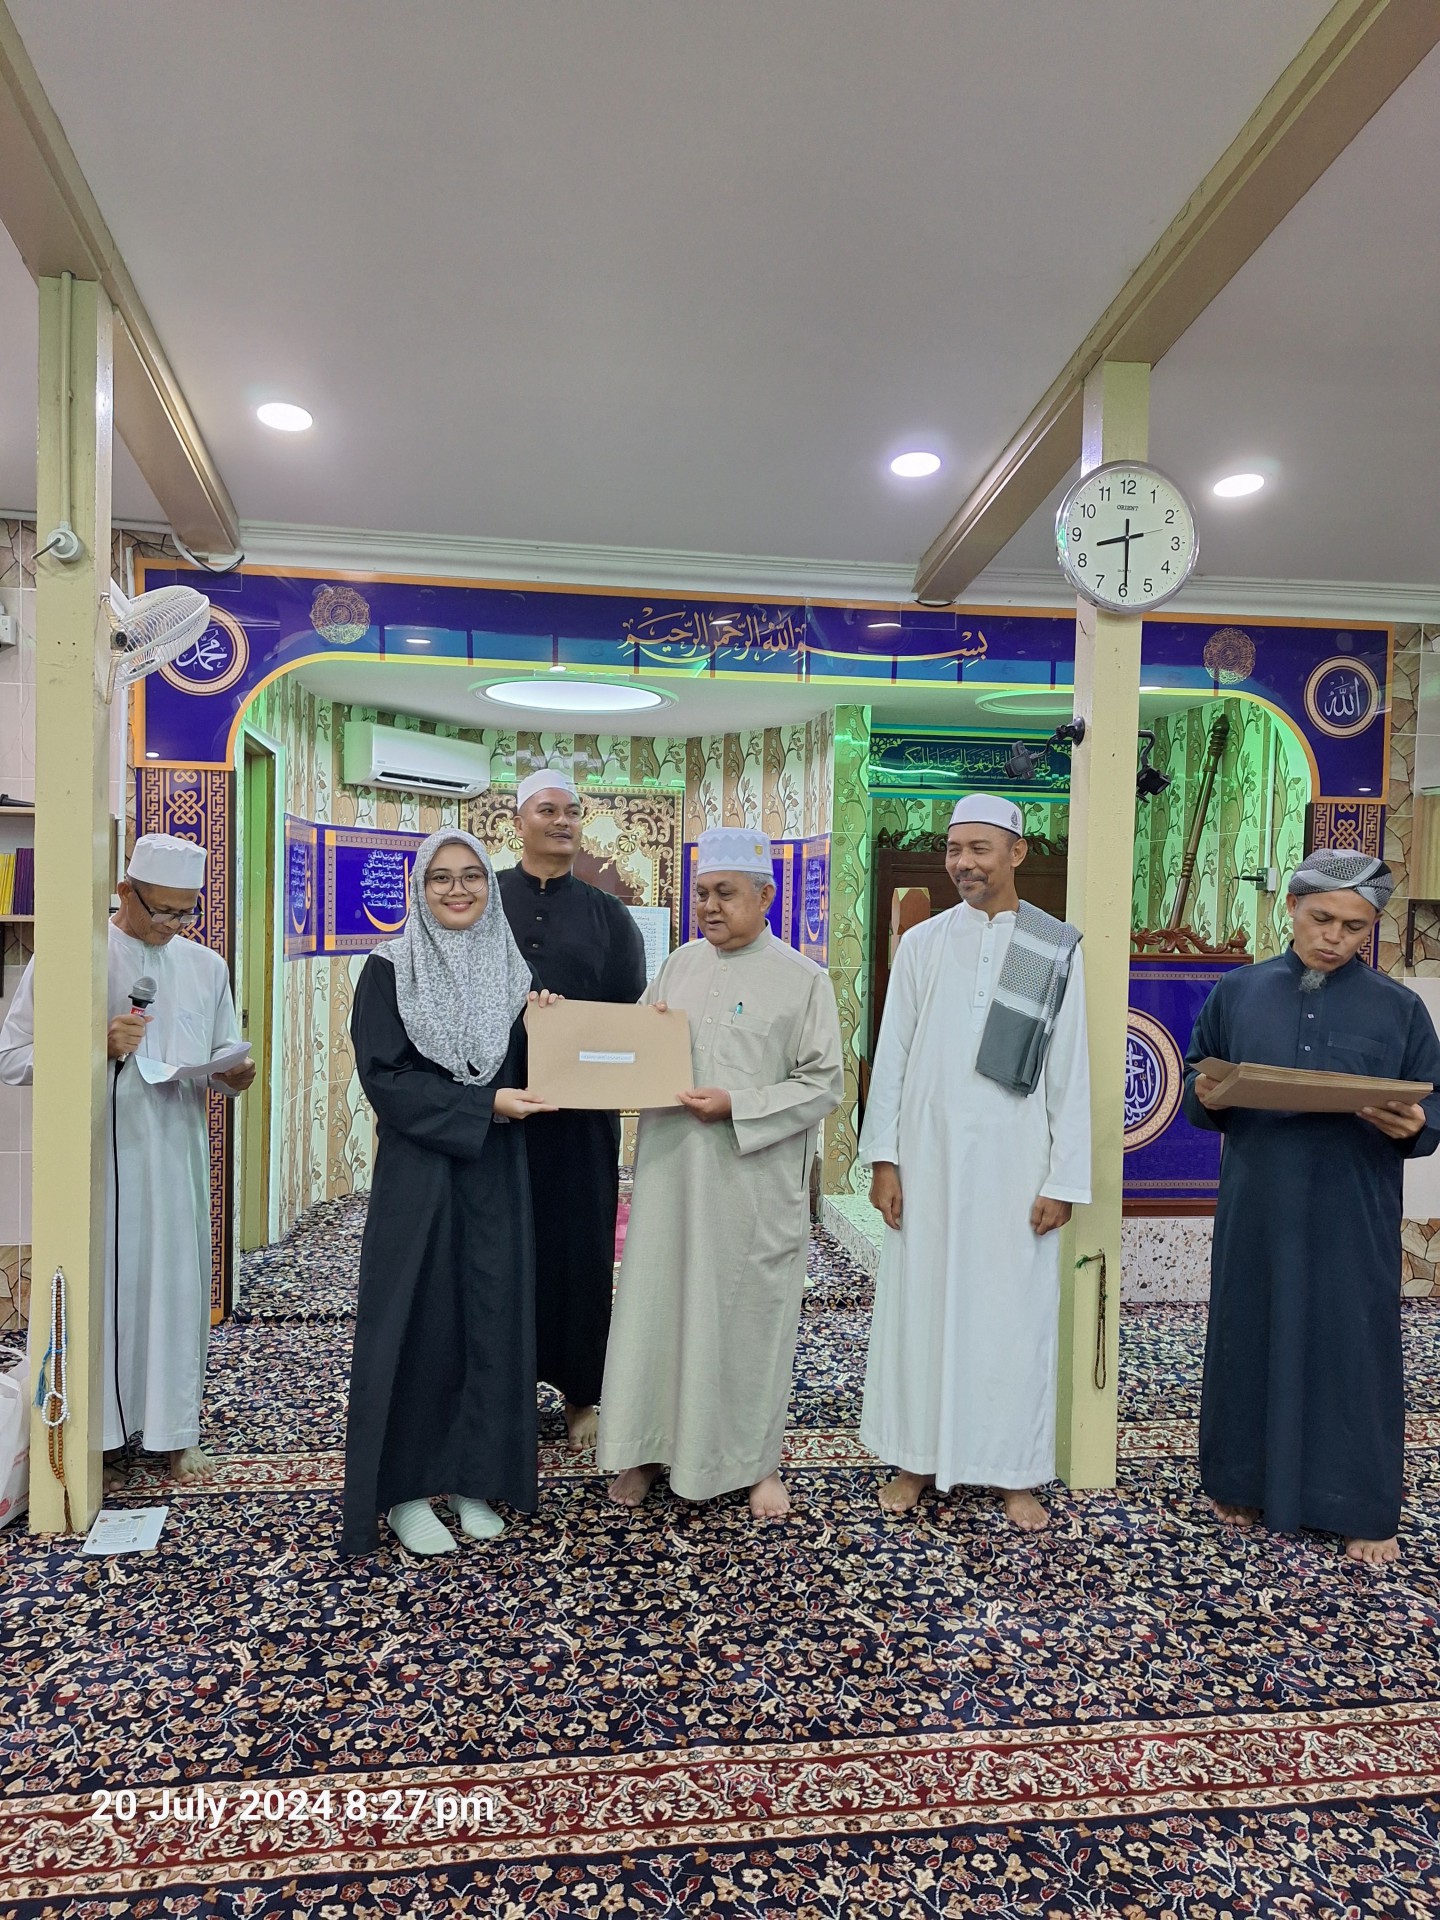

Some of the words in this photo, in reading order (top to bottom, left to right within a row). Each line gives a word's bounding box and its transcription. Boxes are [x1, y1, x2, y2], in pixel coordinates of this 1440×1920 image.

[1099, 487, 1111, 502] 11
[1120, 480, 1137, 495] 12
[1150, 490, 1157, 504] 1
[1080, 504, 1097, 519] 10
[1165, 509, 1175, 525] 2
[1072, 527, 1082, 542] 9
[1171, 536, 1181, 551] 3
[1078, 552, 1088, 567] 8
[1160, 560, 1171, 575] 4
[1095, 574, 1105, 589] 7
[1143, 578, 1154, 593] 5
[1118, 582, 1129, 598] 6
